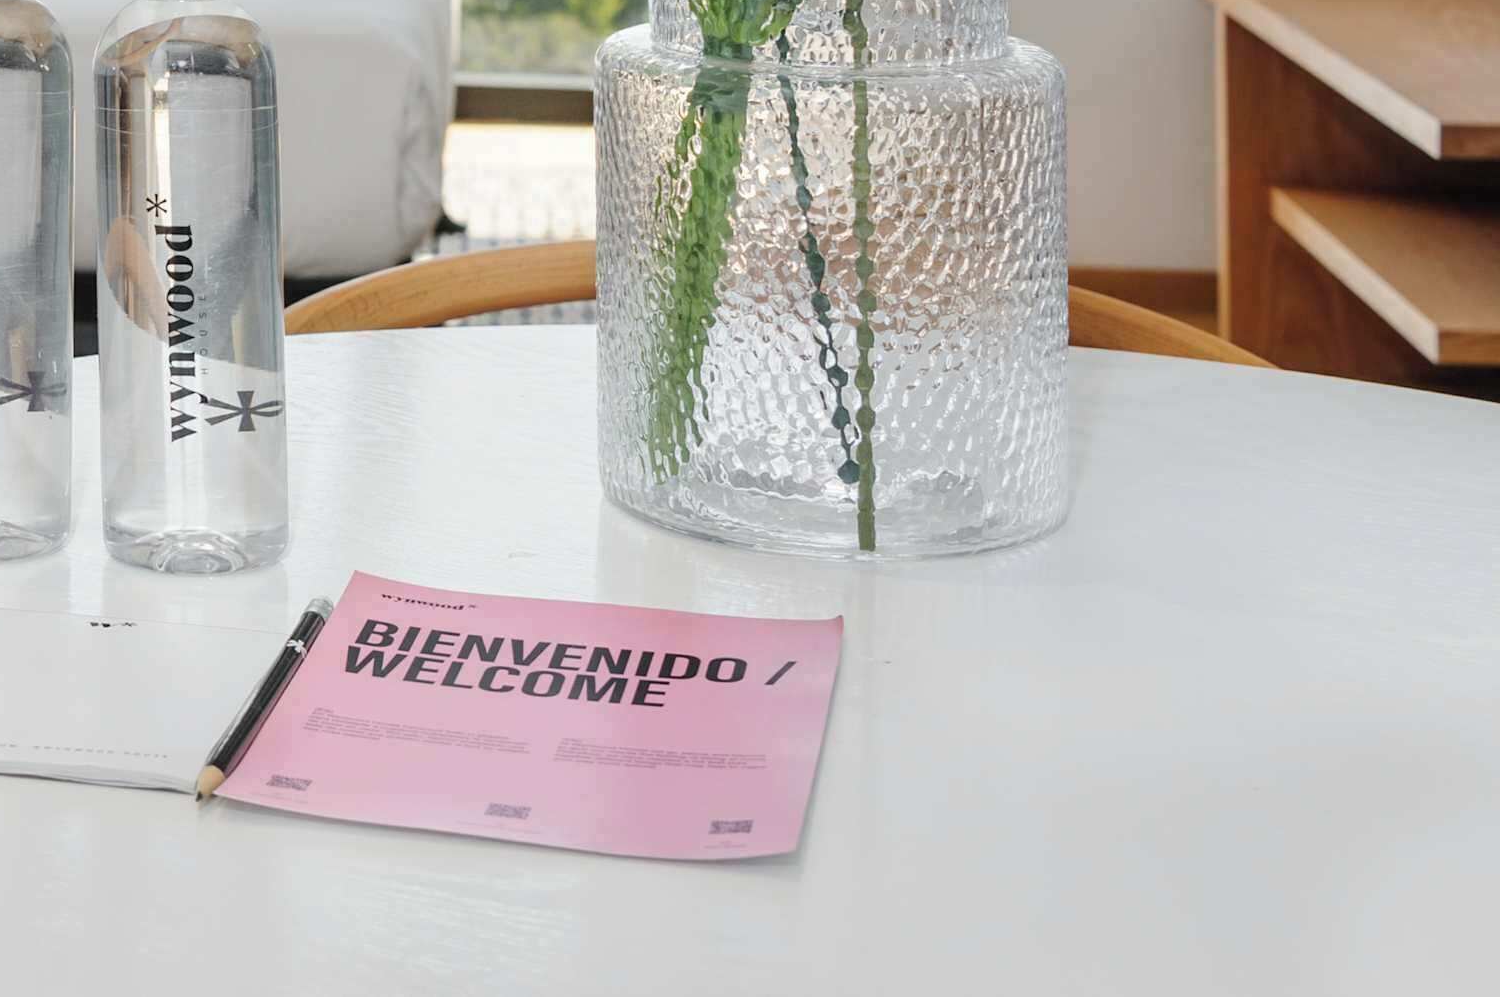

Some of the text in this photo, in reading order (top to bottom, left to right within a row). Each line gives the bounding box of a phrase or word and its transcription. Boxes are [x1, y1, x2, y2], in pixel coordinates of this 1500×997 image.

[155, 225, 209, 442] wynwood
[198, 294, 209, 375] HOUSE
[381, 593, 465, 610] wynwood
[344, 646, 670, 708] WELCOME
[355, 619, 748, 683] BIENVENIDO
